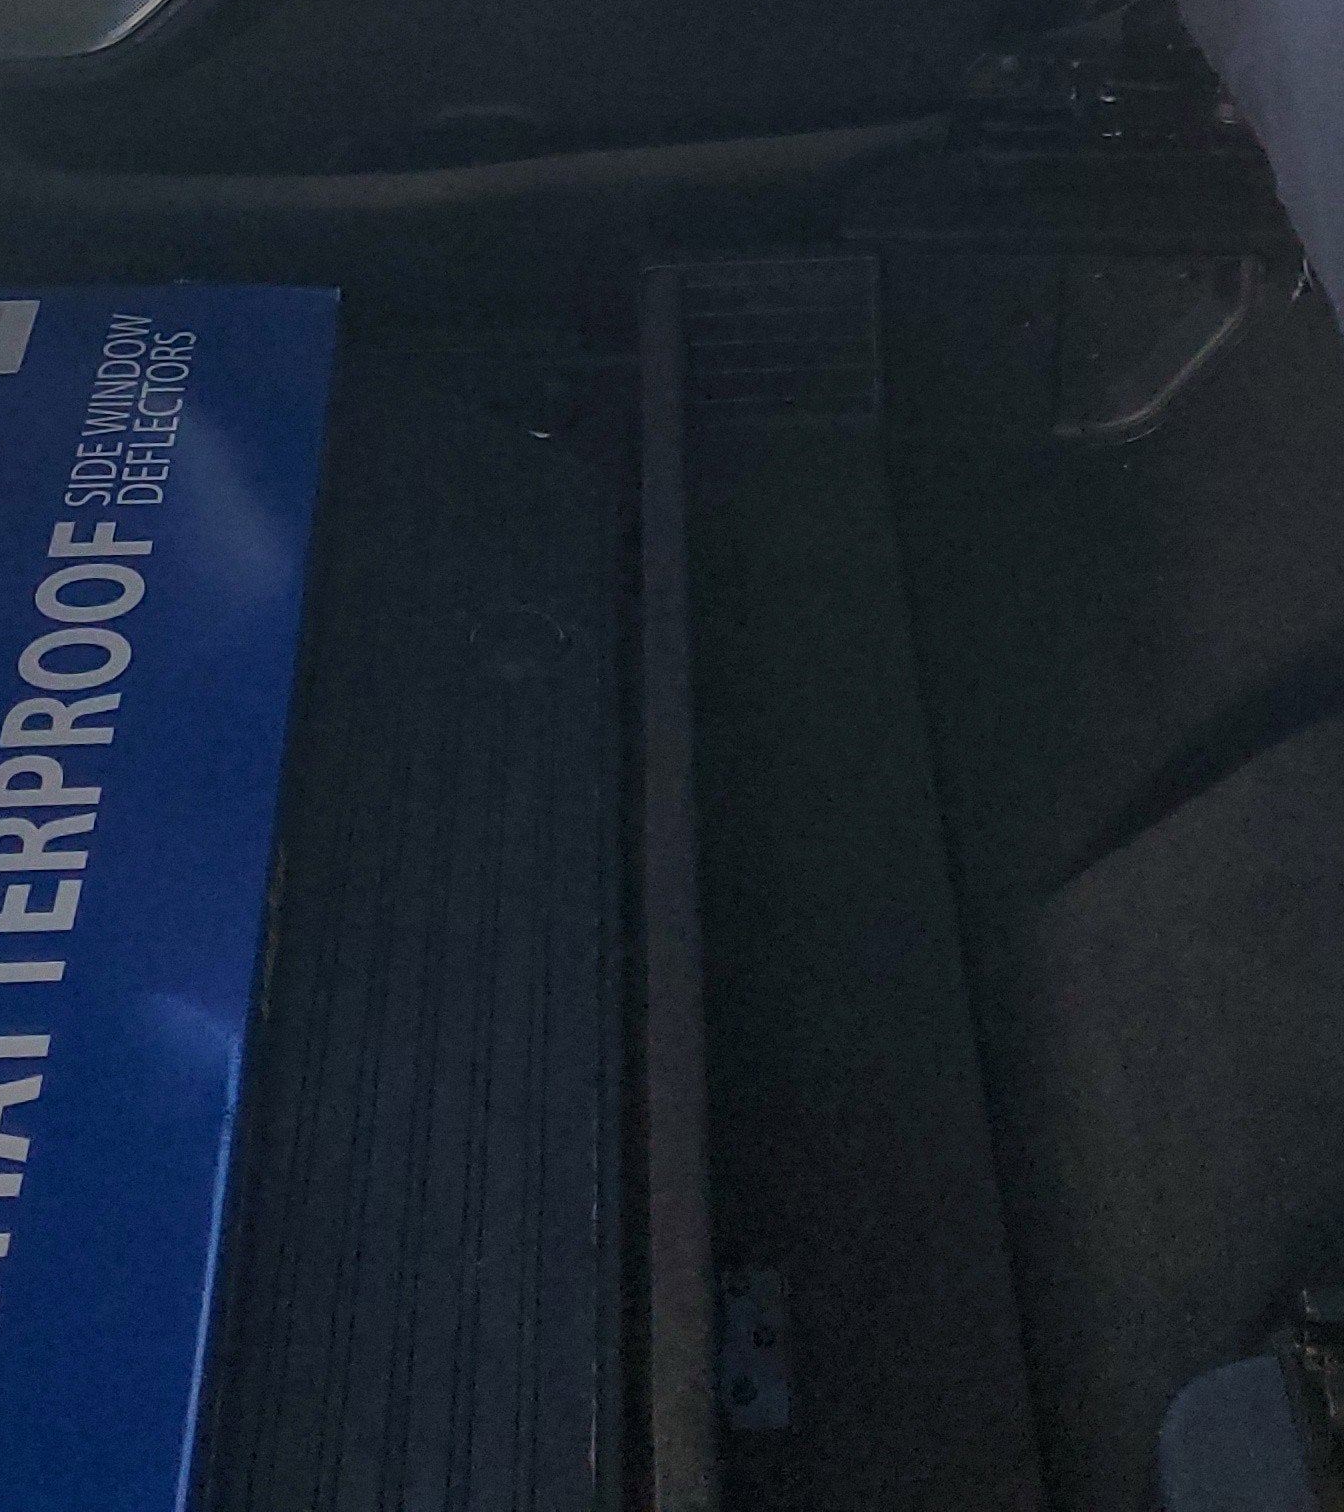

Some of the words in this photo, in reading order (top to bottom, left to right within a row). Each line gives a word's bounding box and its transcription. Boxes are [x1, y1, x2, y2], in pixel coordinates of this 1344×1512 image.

[81, 313, 154, 437] WINDOW
[115, 330, 198, 506] DEFLECTORS
[64, 441, 124, 507] SIDE
